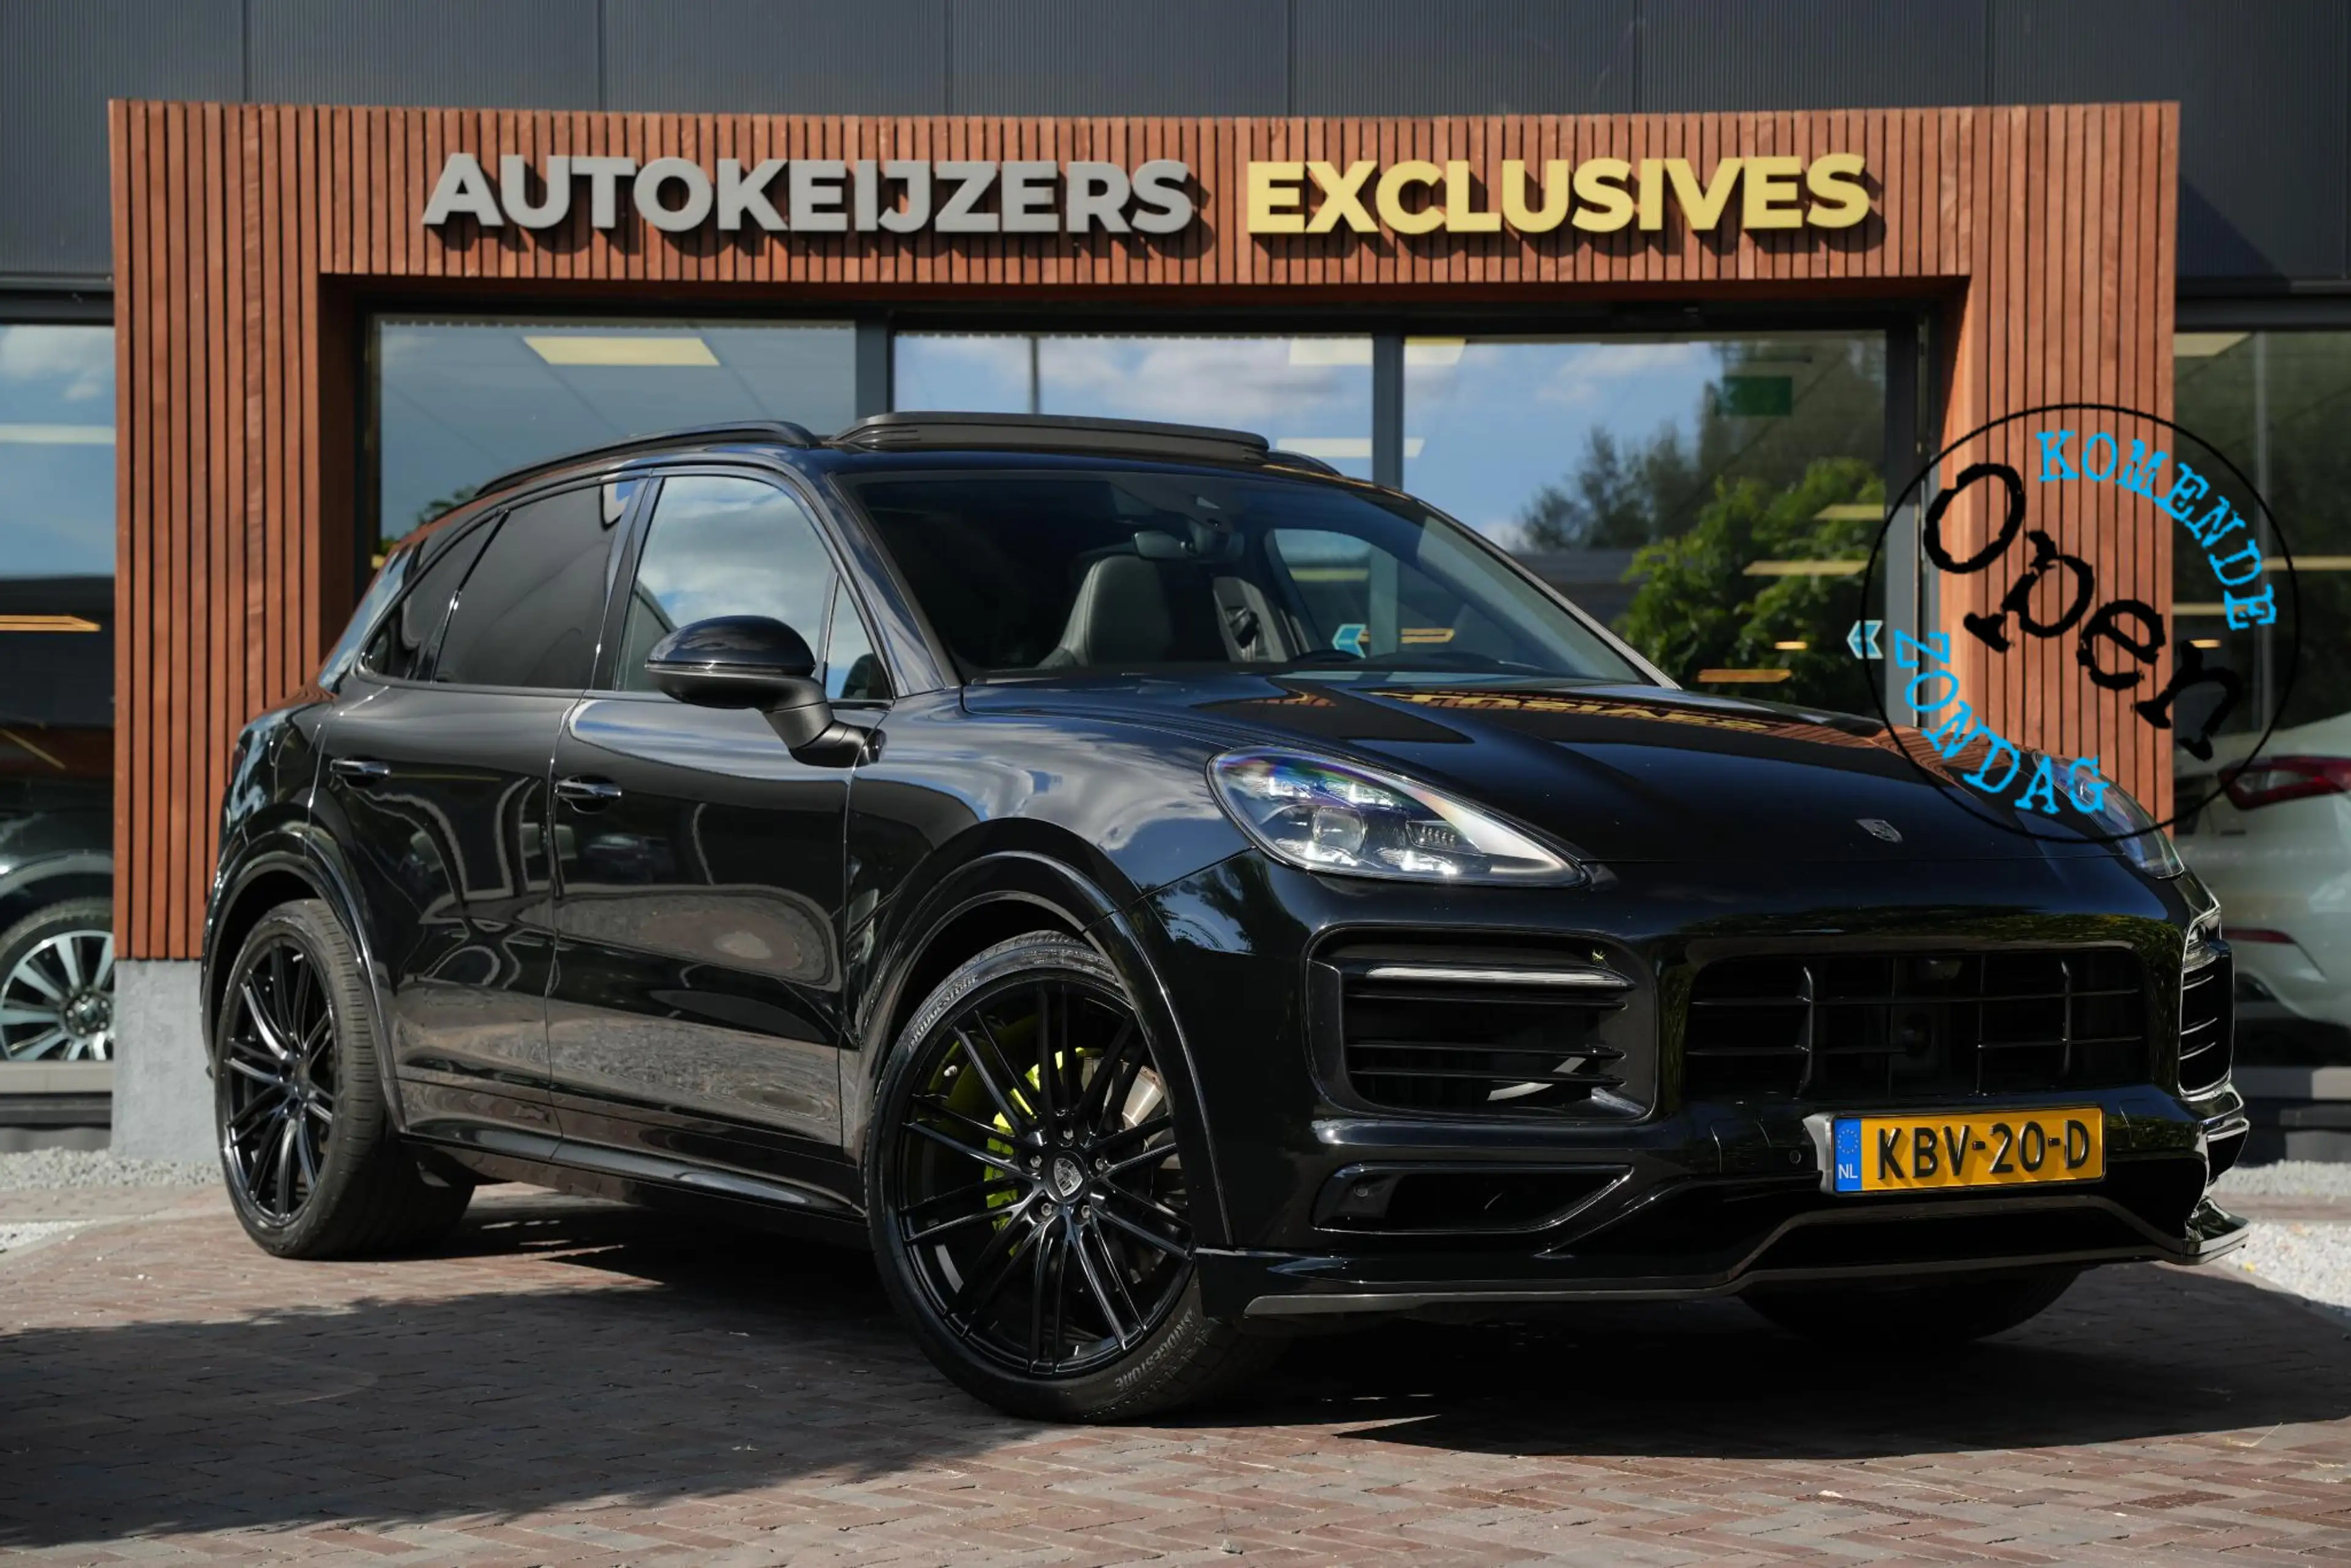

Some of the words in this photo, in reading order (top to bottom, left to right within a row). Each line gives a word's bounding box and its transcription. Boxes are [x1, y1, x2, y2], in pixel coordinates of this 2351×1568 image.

[422, 152, 1195, 234] AUTOKEIJZERS
[1247, 152, 1870, 234] EXCLUSIVES
[1838, 1164, 1859, 1179] NL
[1877, 1119, 2090, 1180] KBV-20-D
